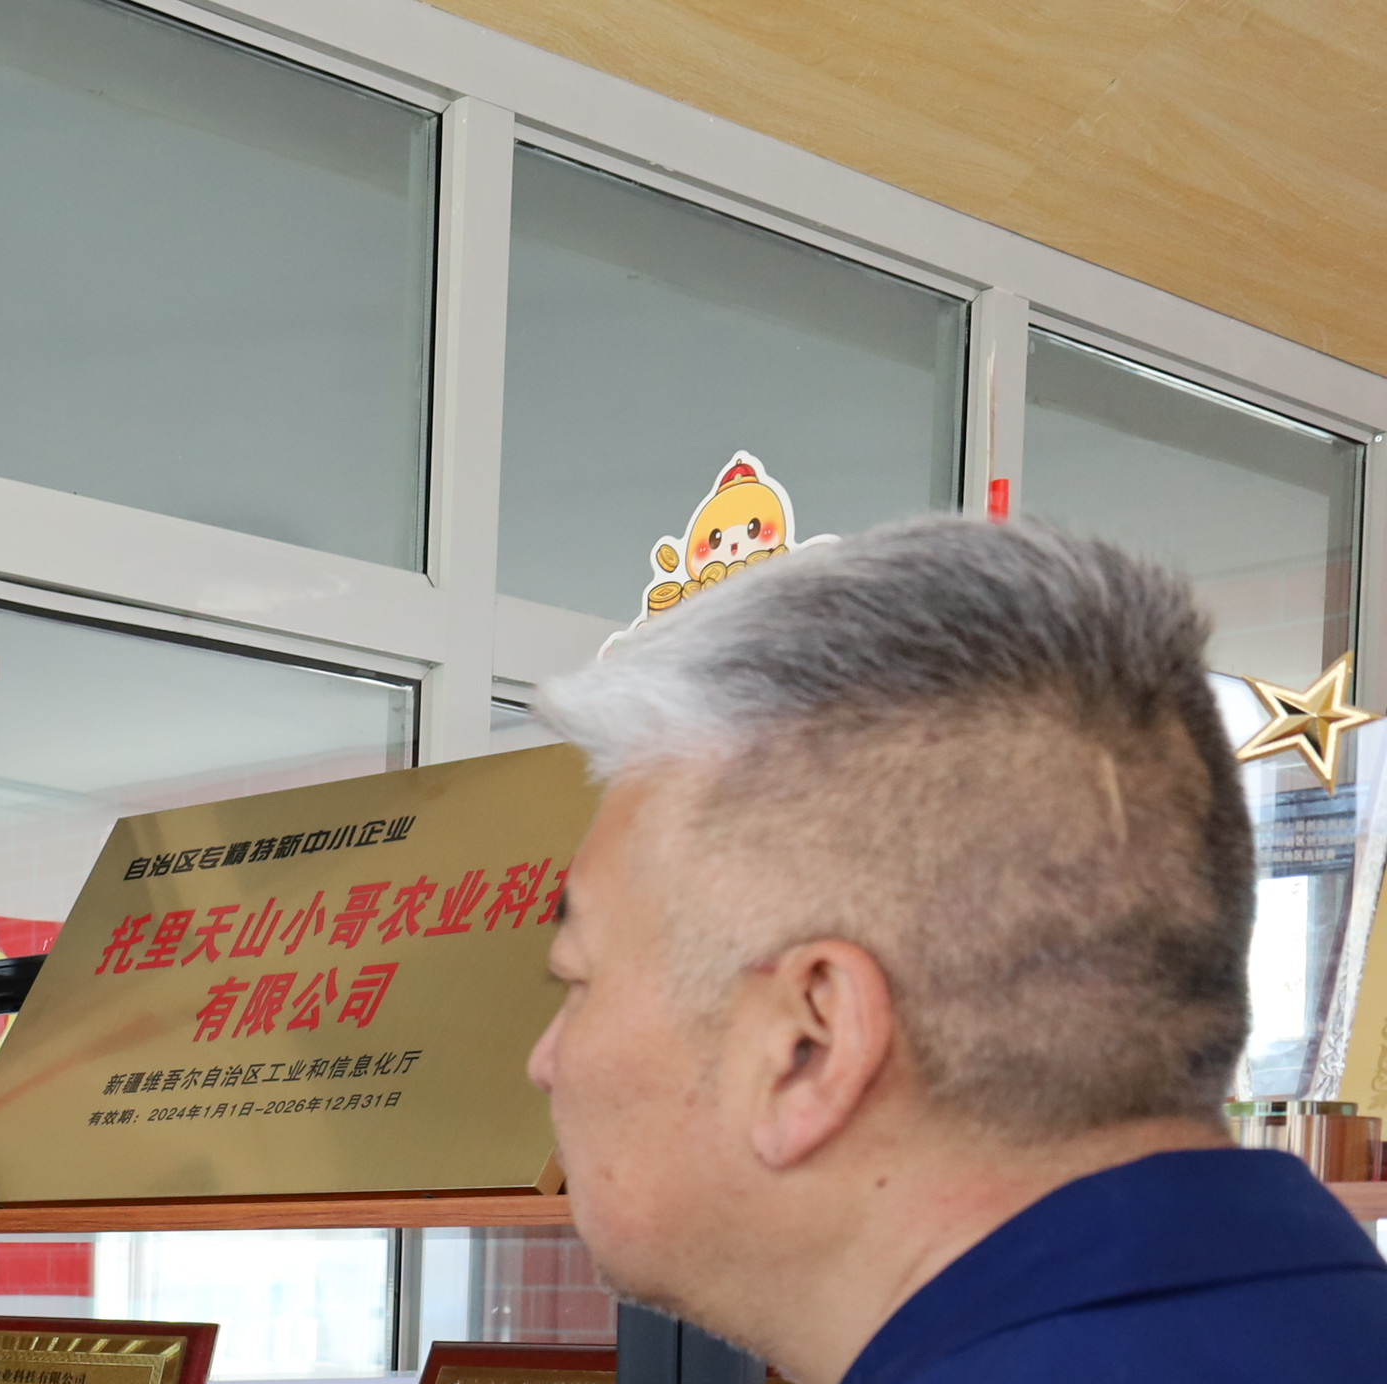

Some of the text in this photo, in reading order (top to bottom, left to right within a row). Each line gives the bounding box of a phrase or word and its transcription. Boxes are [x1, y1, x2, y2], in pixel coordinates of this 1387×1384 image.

[123, 815, 416, 881] 自治区专精特新中小企业
[192, 962, 400, 1042] 有限公司
[103, 1049, 423, 1096] 新疆维吾尔自治区工业和信息化厅
